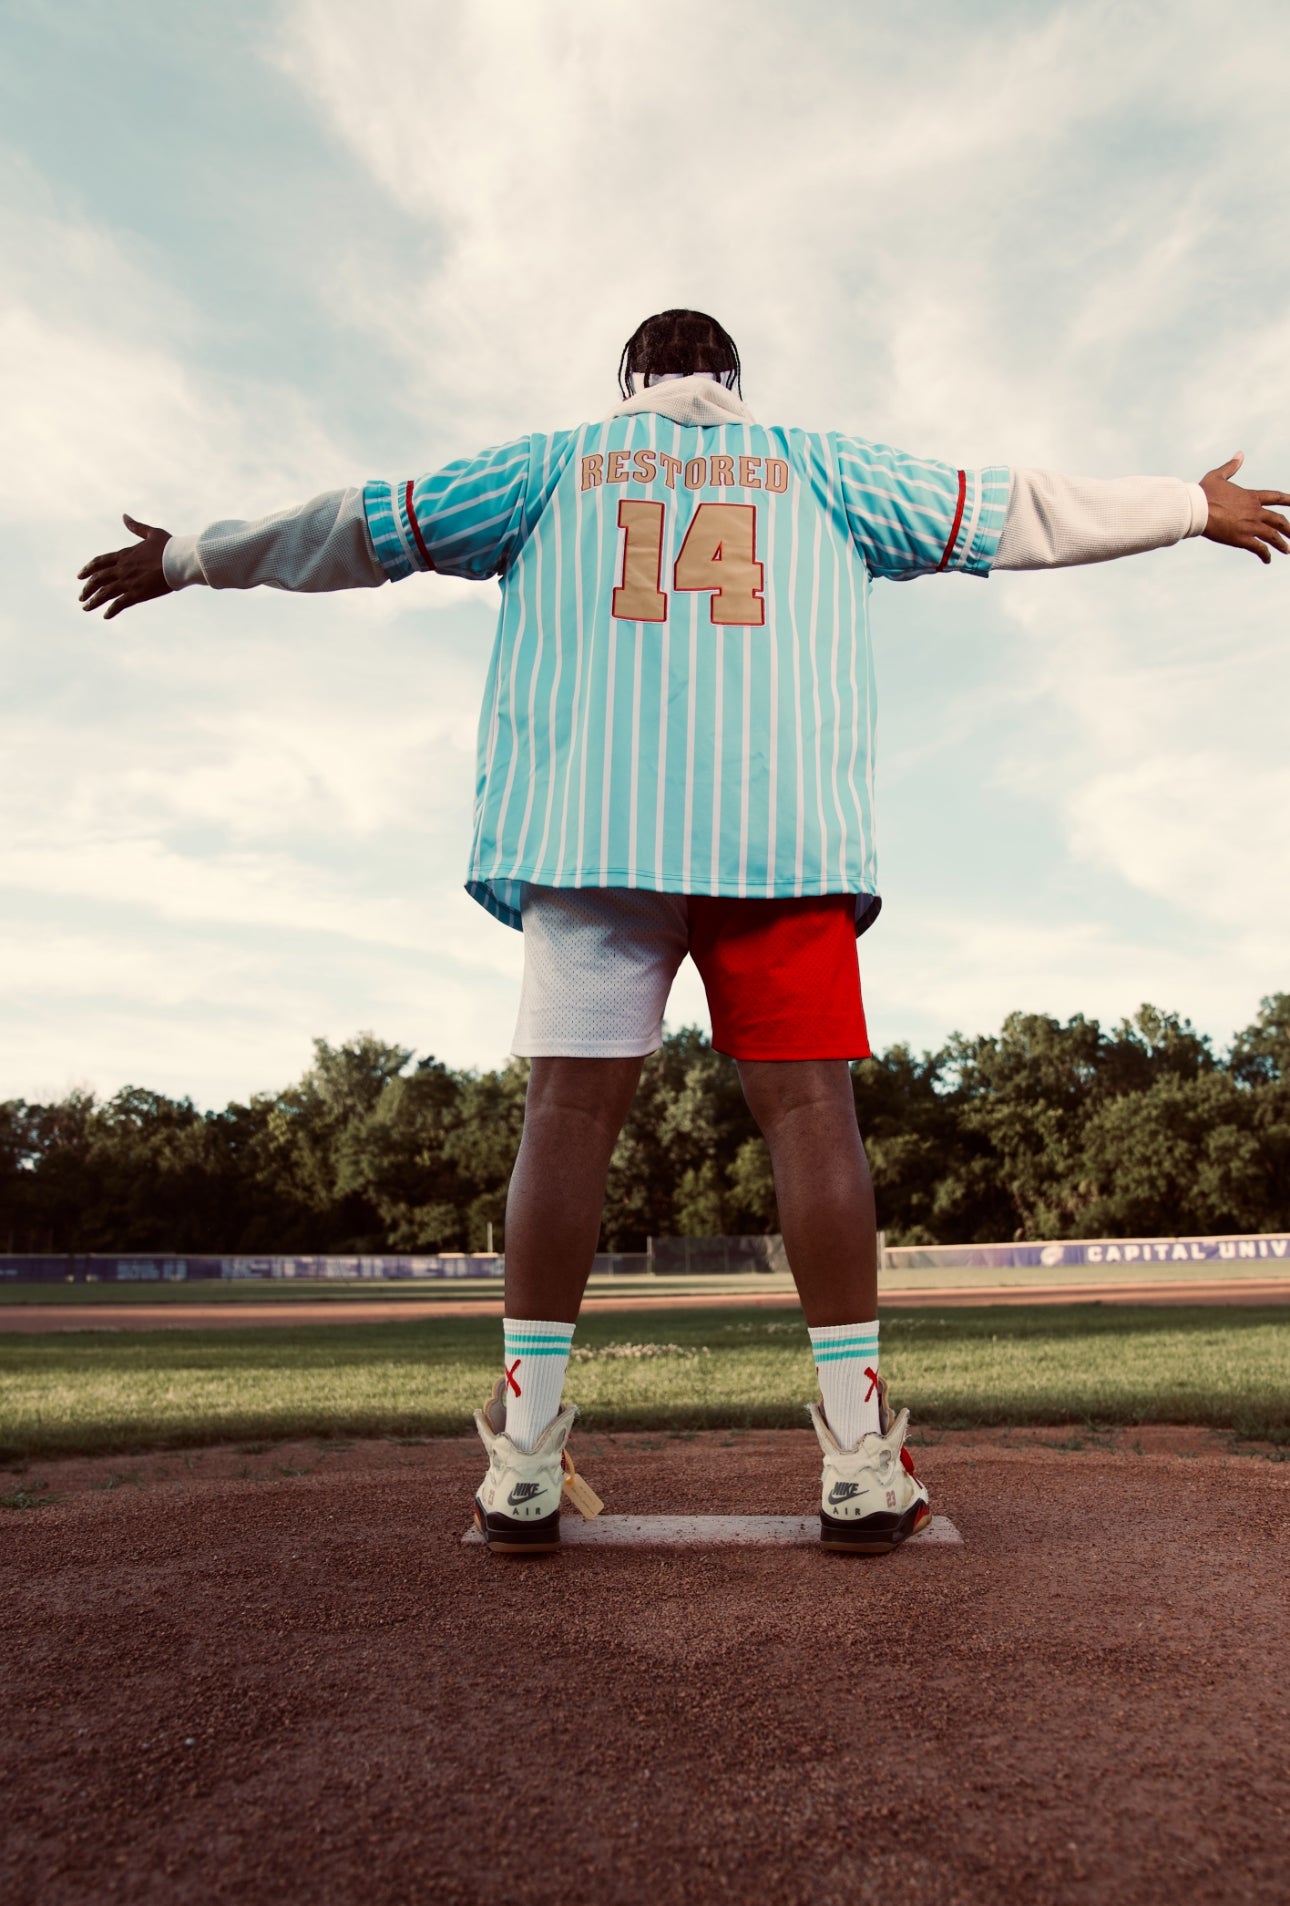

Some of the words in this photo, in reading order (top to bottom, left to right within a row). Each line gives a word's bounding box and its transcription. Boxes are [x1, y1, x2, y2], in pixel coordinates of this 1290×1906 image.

[580, 449, 789, 494] RESTORED
[611, 499, 765, 626] 14
[1087, 1243, 1206, 1262] CAPITAL
[512, 1482, 540, 1497] NIKE
[832, 1481, 859, 1496] NIKE
[512, 1506, 542, 1516] AIR
[832, 1506, 861, 1516] AIR
